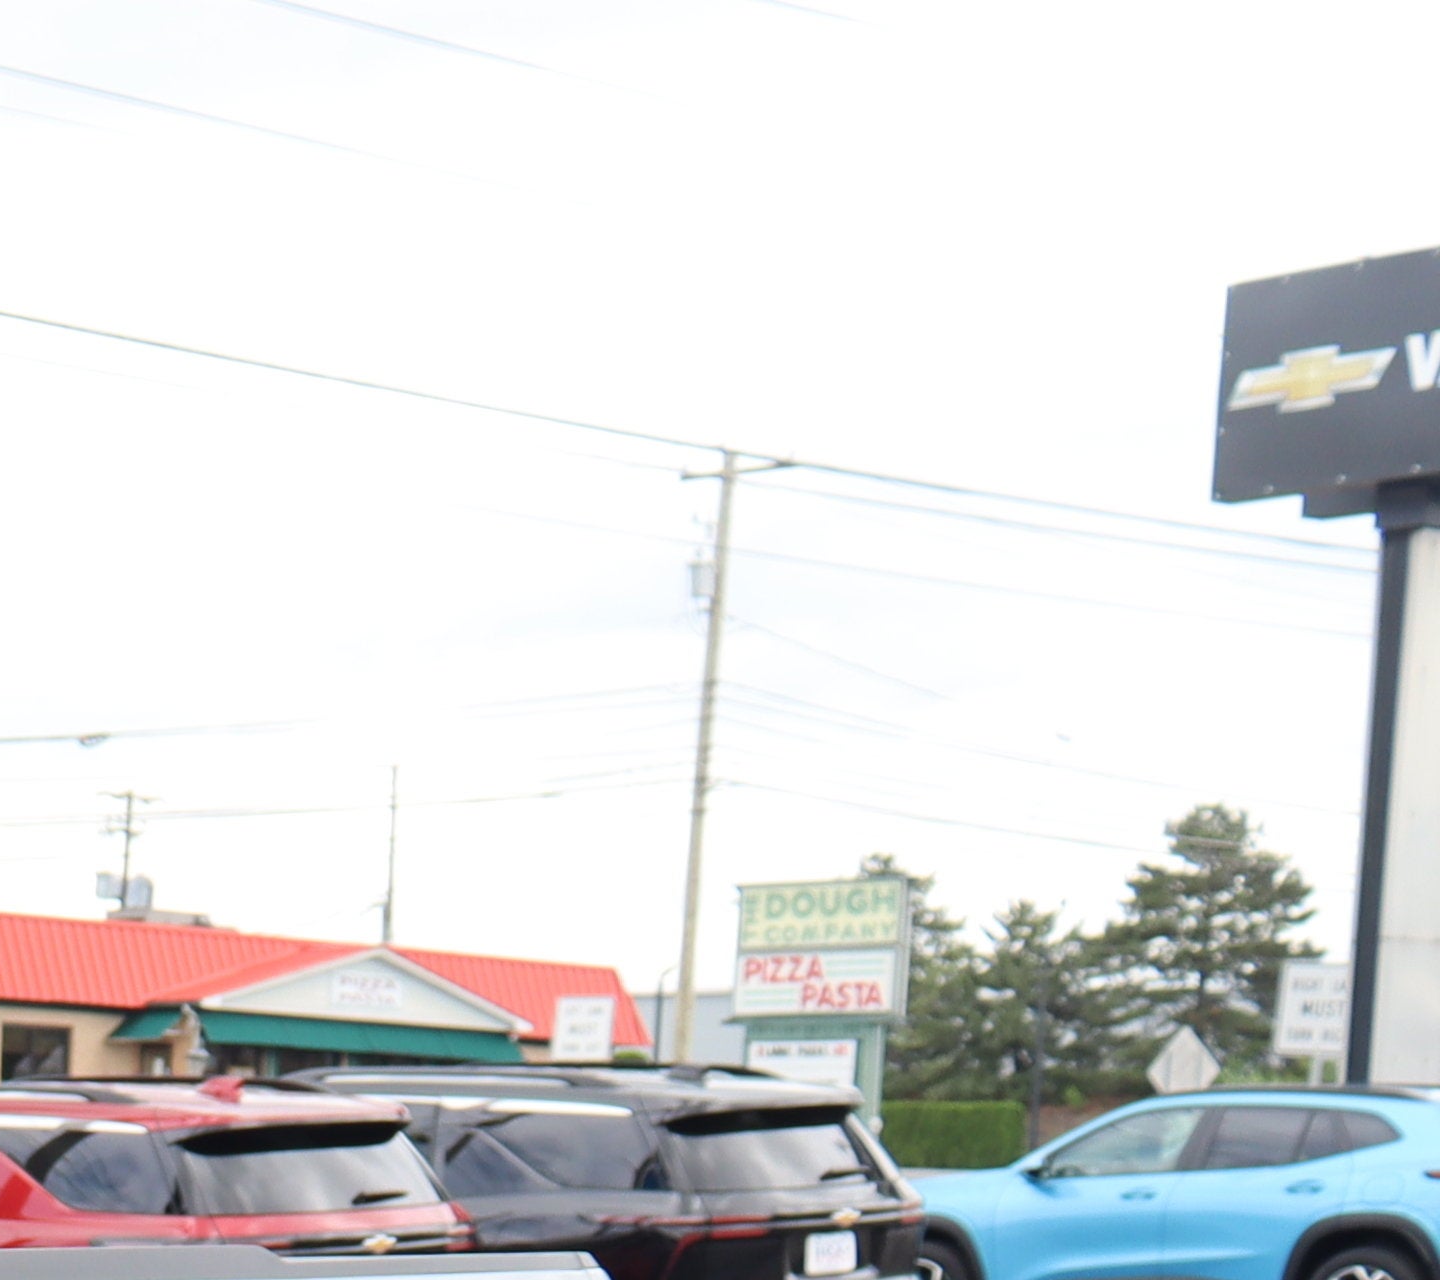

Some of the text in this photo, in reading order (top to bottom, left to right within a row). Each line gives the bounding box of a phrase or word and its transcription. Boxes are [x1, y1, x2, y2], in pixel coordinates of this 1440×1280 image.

[765, 883, 898, 920] DOUGH
[765, 922, 896, 942] COMPANY
[744, 954, 825, 983] PIZZA
[801, 981, 883, 1009] PASTA
